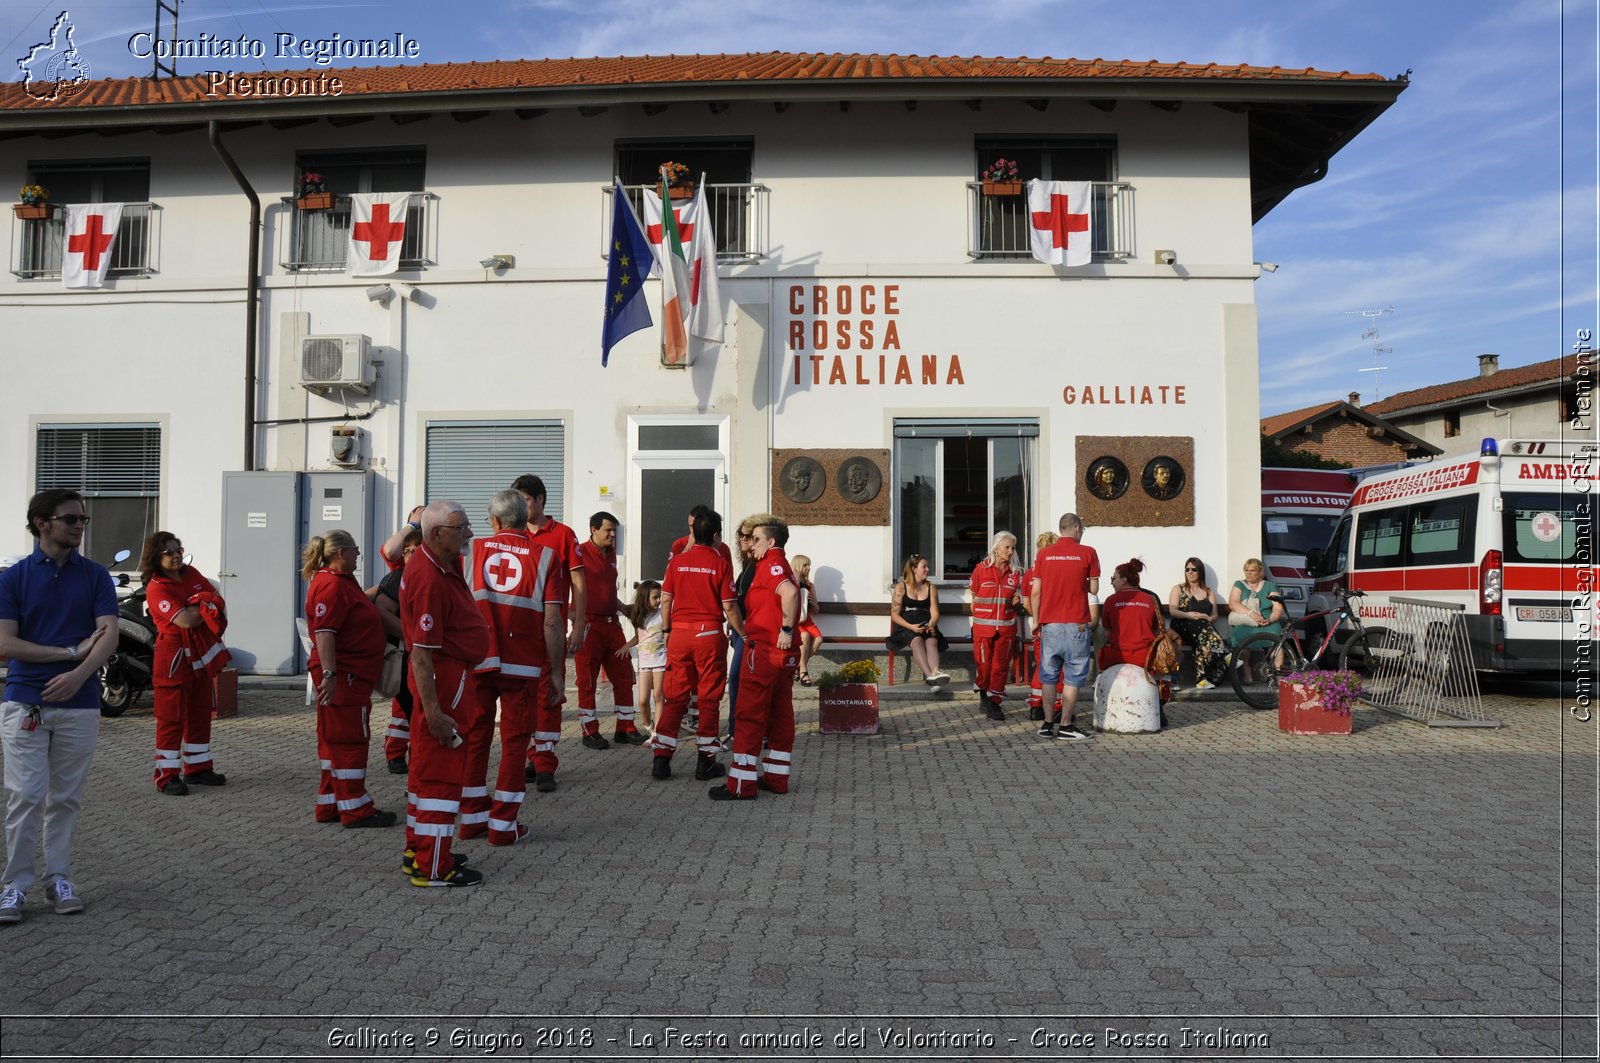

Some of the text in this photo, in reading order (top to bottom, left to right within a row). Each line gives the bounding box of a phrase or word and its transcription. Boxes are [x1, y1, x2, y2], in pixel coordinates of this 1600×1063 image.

[789, 285, 900, 315] CROCE
[789, 320, 901, 350] ROSSA
[794, 355, 965, 385] ITALIANA
[1063, 385, 1186, 405] GALLIATE
[1368, 470, 1465, 498] CROCE ROSSA ITALIANA
[1359, 606, 1397, 619] GALLIATE
[1520, 609, 1534, 619] CRI
